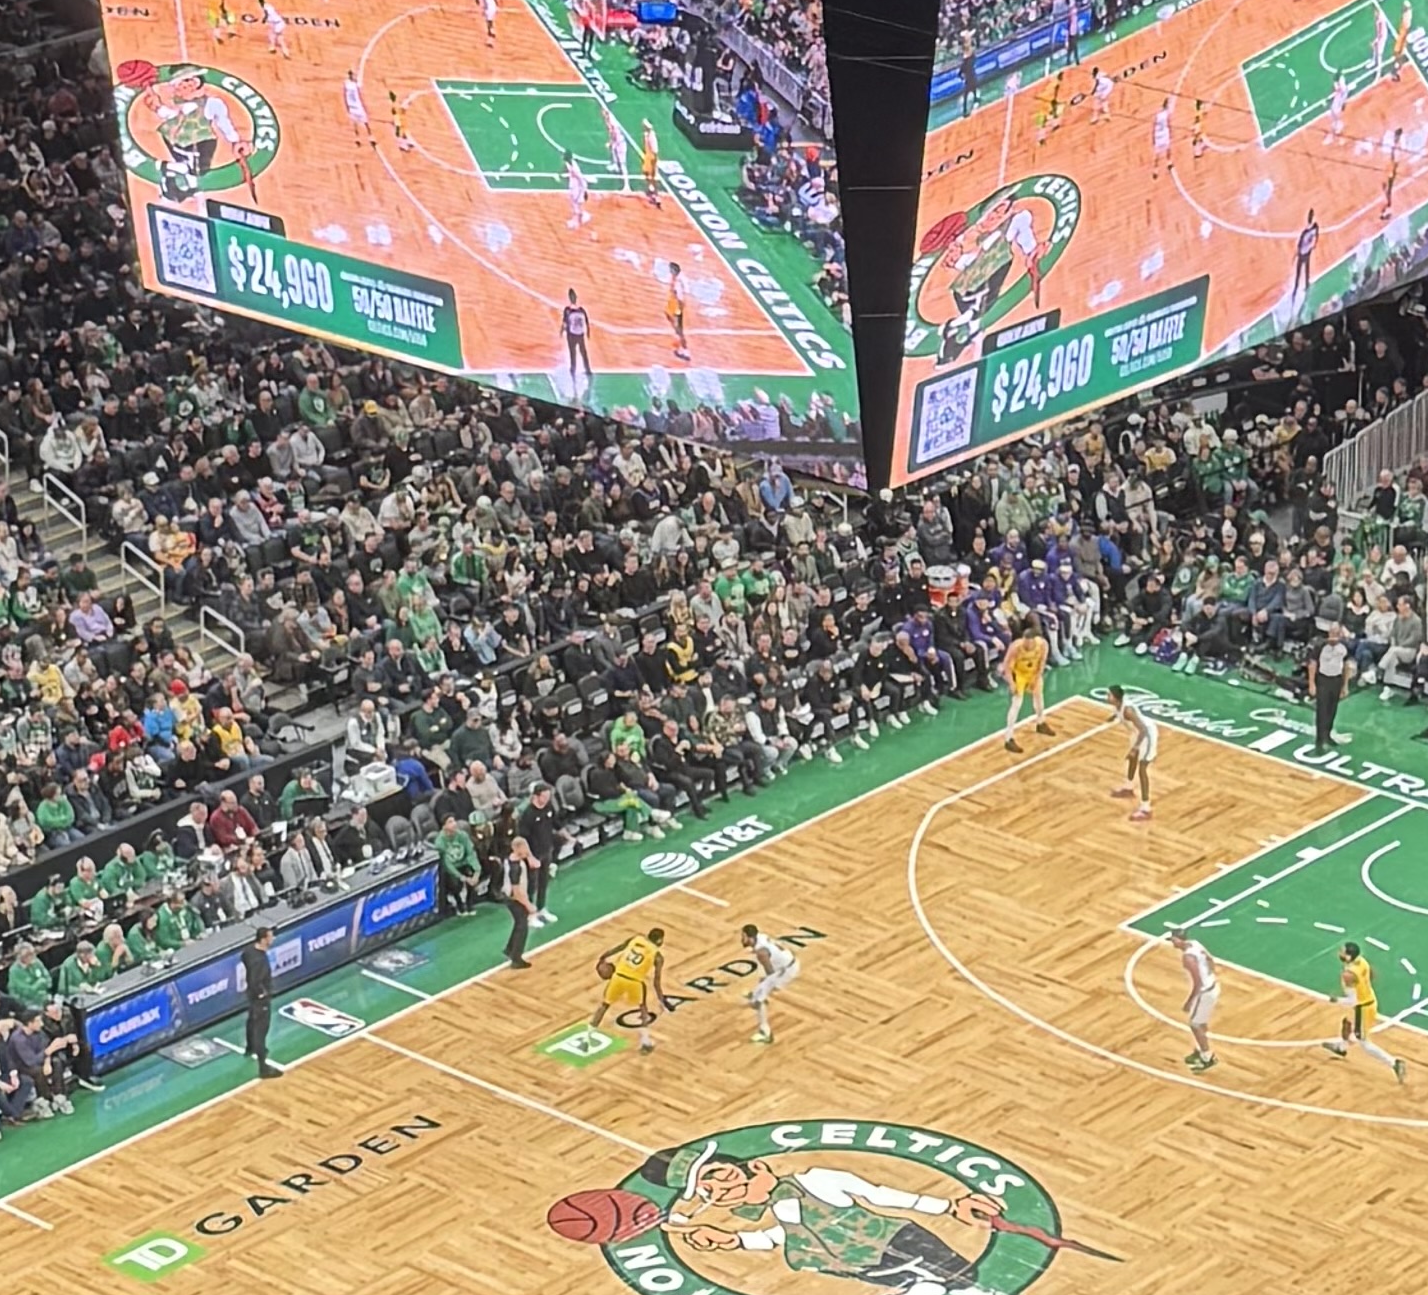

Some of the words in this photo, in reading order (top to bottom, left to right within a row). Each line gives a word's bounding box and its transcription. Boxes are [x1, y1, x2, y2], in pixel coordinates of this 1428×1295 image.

[220, 75, 278, 152] CELTICS
[657, 159, 749, 252] BOSTON
[1032, 174, 1072, 246] CELTICS
[227, 235, 335, 314] $24,960
[351, 284, 395, 323] 50/50
[736, 257, 848, 371] CELTICS
[991, 333, 1096, 424] $24,960
[690, 814, 775, 861] AT&T
[307, 925, 348, 953] TUESDAY
[187, 978, 230, 1005] TUESDAY
[112, 1236, 189, 1272] TD
[194, 1114, 444, 1237] GARDEN
[769, 1122, 1026, 1197] CELTICS
